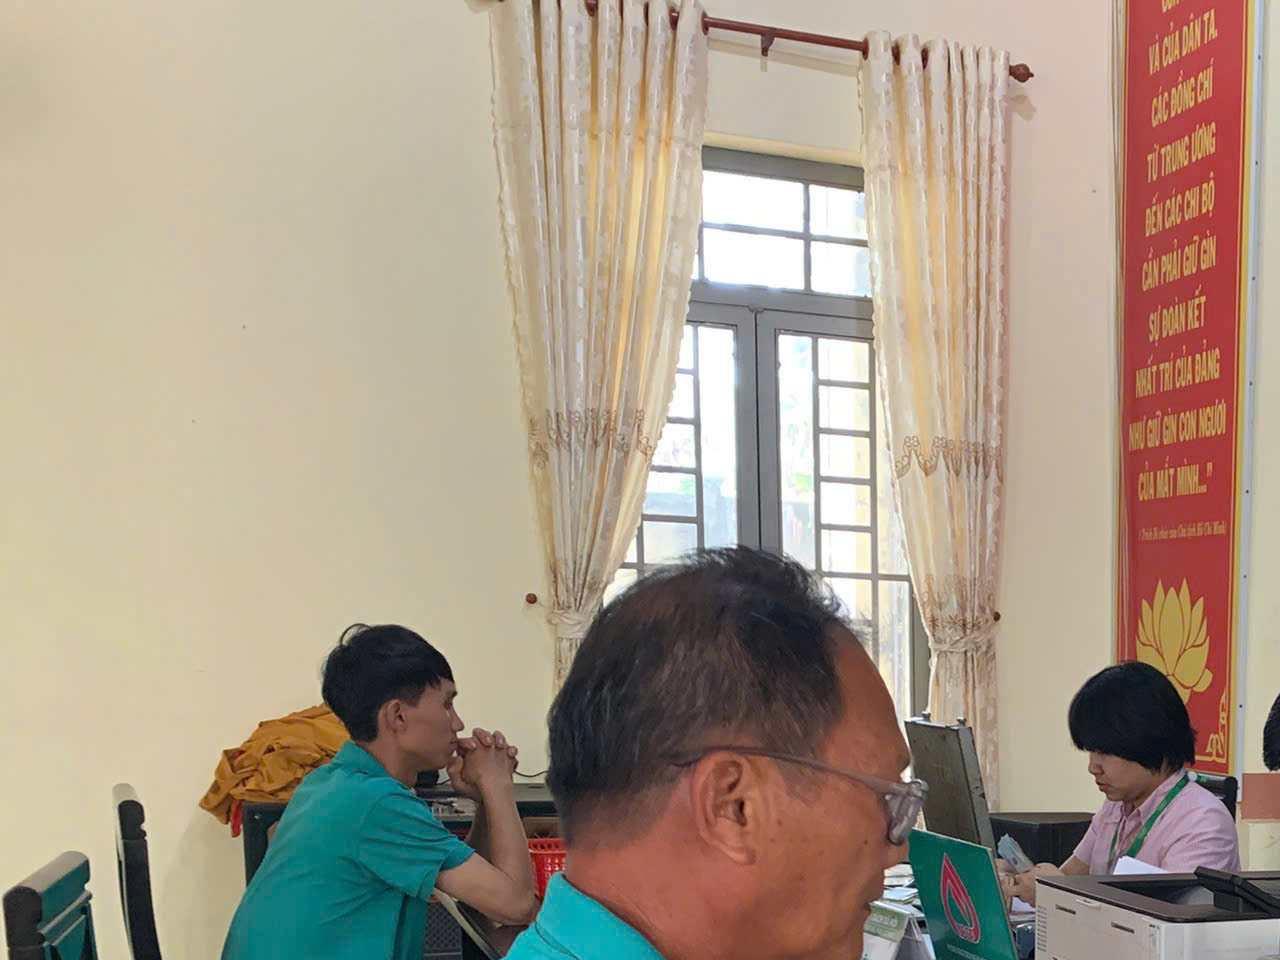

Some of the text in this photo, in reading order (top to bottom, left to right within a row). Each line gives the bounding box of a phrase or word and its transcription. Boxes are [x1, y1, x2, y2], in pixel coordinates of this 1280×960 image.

[1149, 33, 1160, 75] VÀ
[1162, 21, 1180, 68] CỦA
[1182, 12, 1201, 57] DÂN
[1151, 57, 1213, 128] CÁC ĐỒNG CHÍ
[1160, 135, 1189, 177] TRUNG
[1191, 121, 1216, 163] ƯƠNG
[1145, 171, 1215, 238] ĐẾN CÁC CHI BỘ
[1142, 229, 1217, 292] CẦN PHẢI GIỮ GÌN
[1148, 283, 1206, 347] SỰ ĐOÀN KẾT
[1135, 338, 1220, 399] NHẤT TRÍ CỦA ĐẢNG
[1128, 415, 1147, 452] NHƯ
[1147, 410, 1162, 449] GIỮ
[1163, 407, 1178, 446] GÌN
[1180, 408, 1198, 442] CON
[1138, 461, 1154, 502] CỦA
[1156, 456, 1175, 499] MẮT
